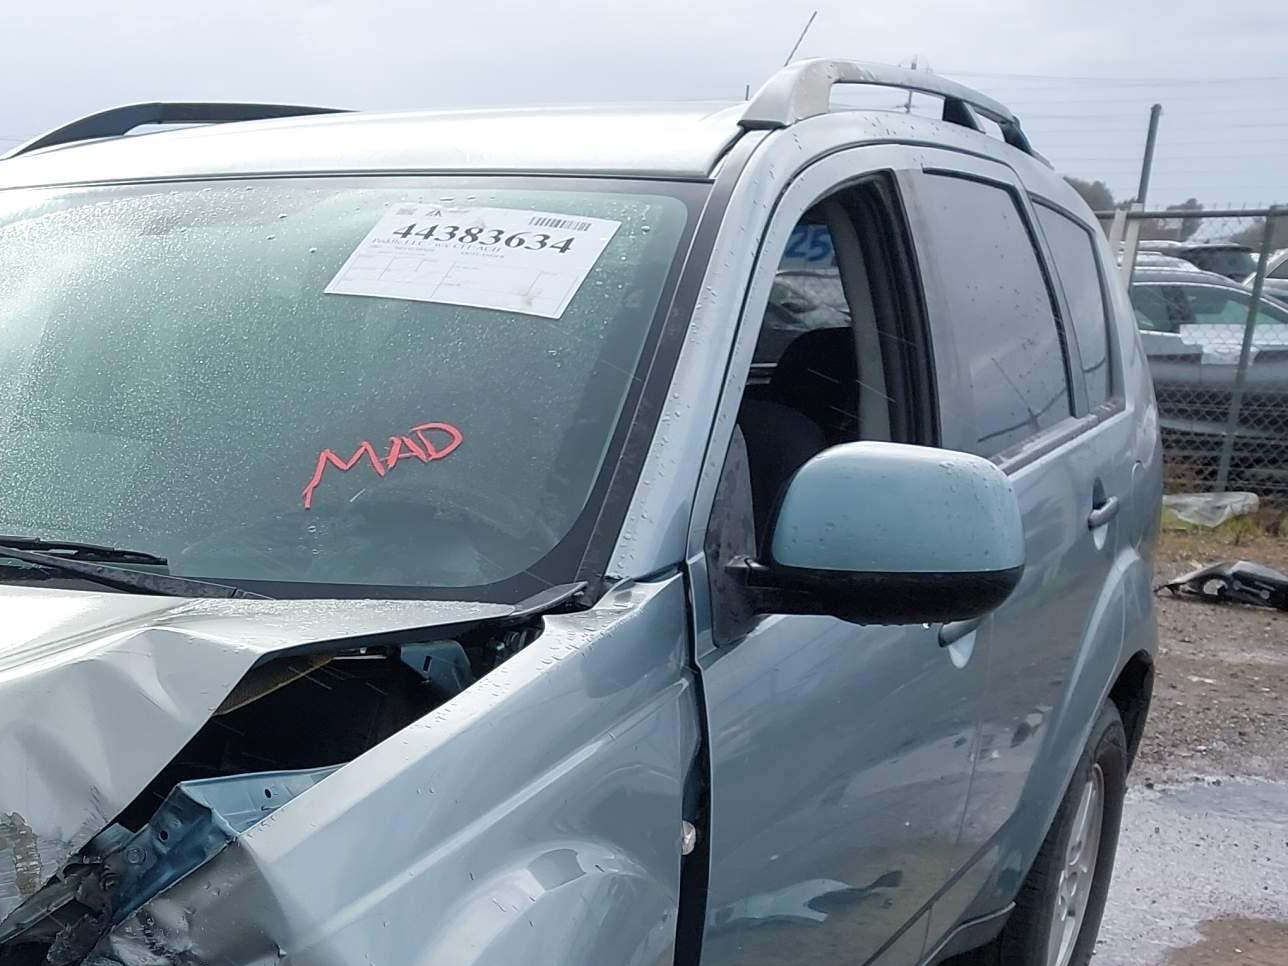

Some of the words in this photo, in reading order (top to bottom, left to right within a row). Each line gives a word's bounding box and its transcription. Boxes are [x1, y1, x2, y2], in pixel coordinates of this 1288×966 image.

[393, 223, 575, 254] 44383634
[785, 224, 832, 262] 25
[302, 422, 463, 510] MAD
